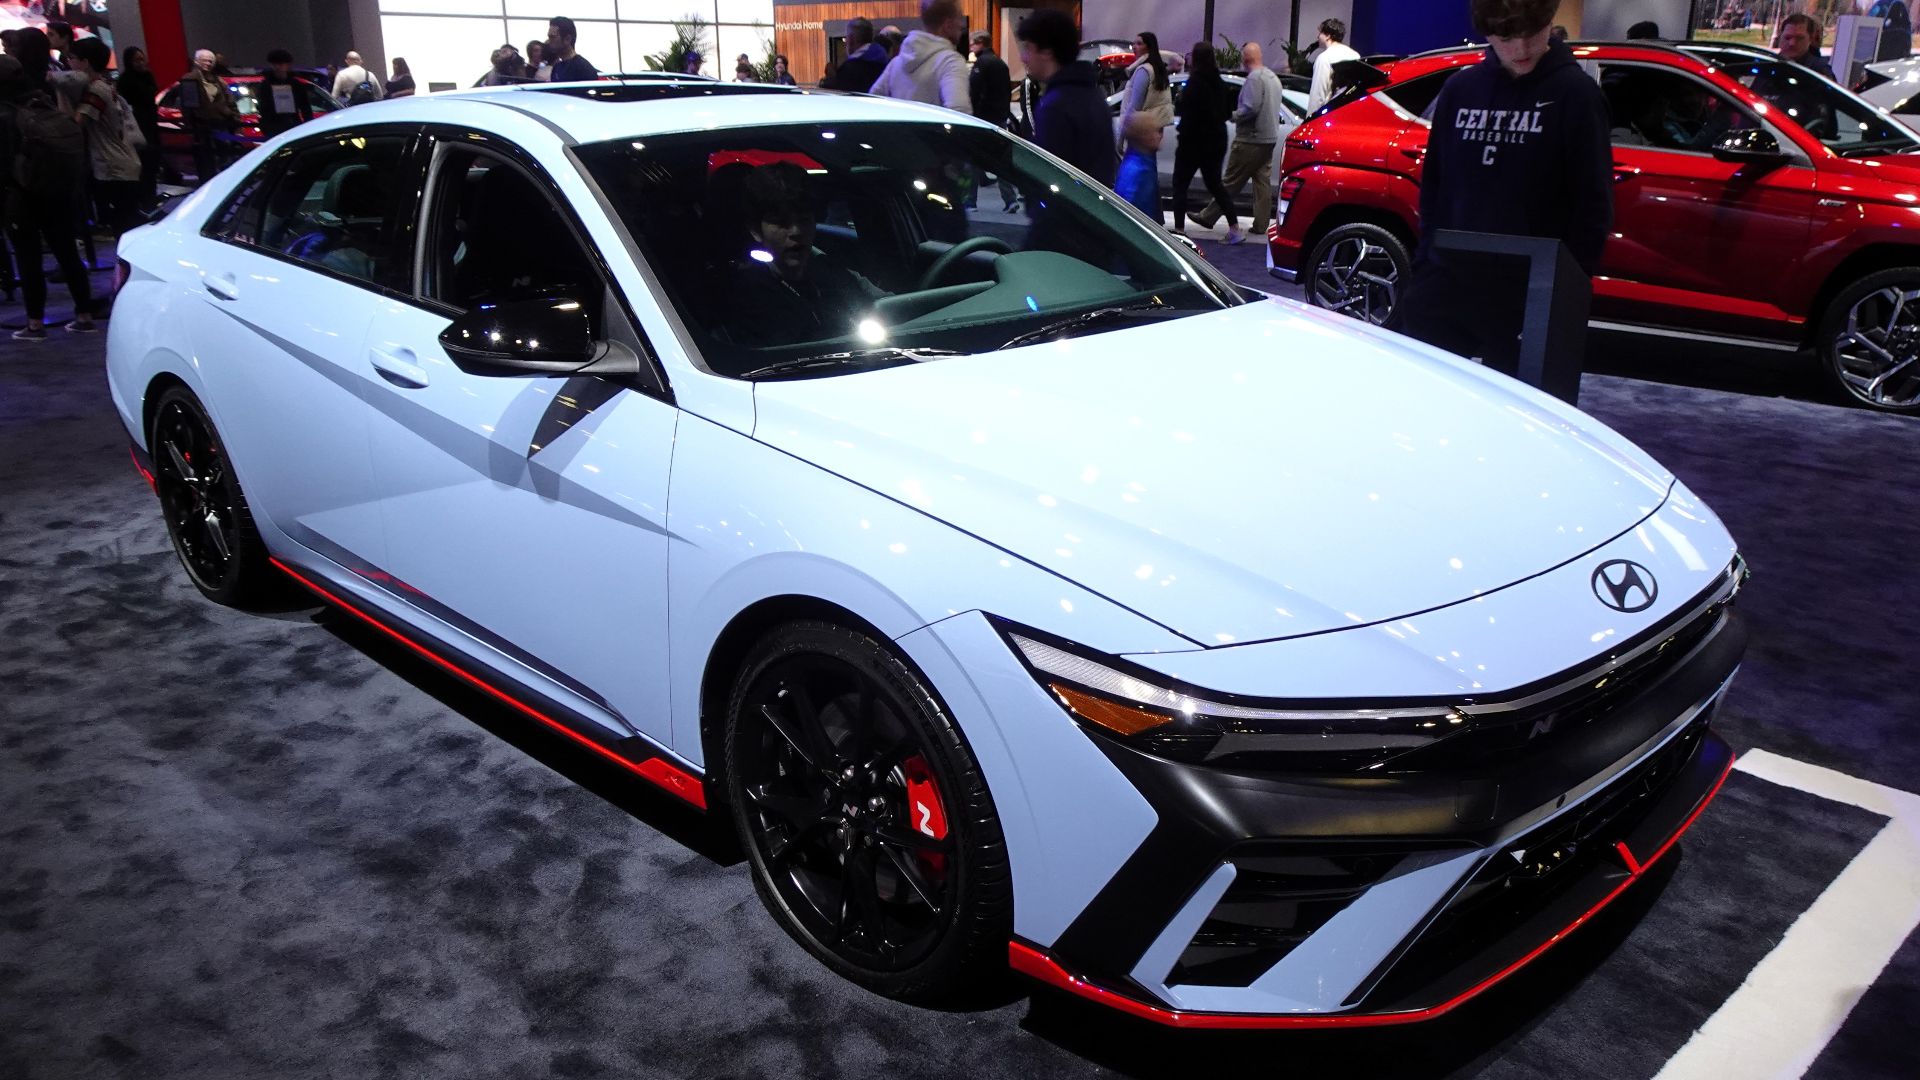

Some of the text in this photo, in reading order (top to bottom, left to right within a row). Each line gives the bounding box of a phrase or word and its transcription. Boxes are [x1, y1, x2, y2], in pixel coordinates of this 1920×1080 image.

[775, 20, 823, 32] Hyundai Home
[1455, 108, 1543, 133] CENTRAL
[1482, 145, 1497, 165] C
